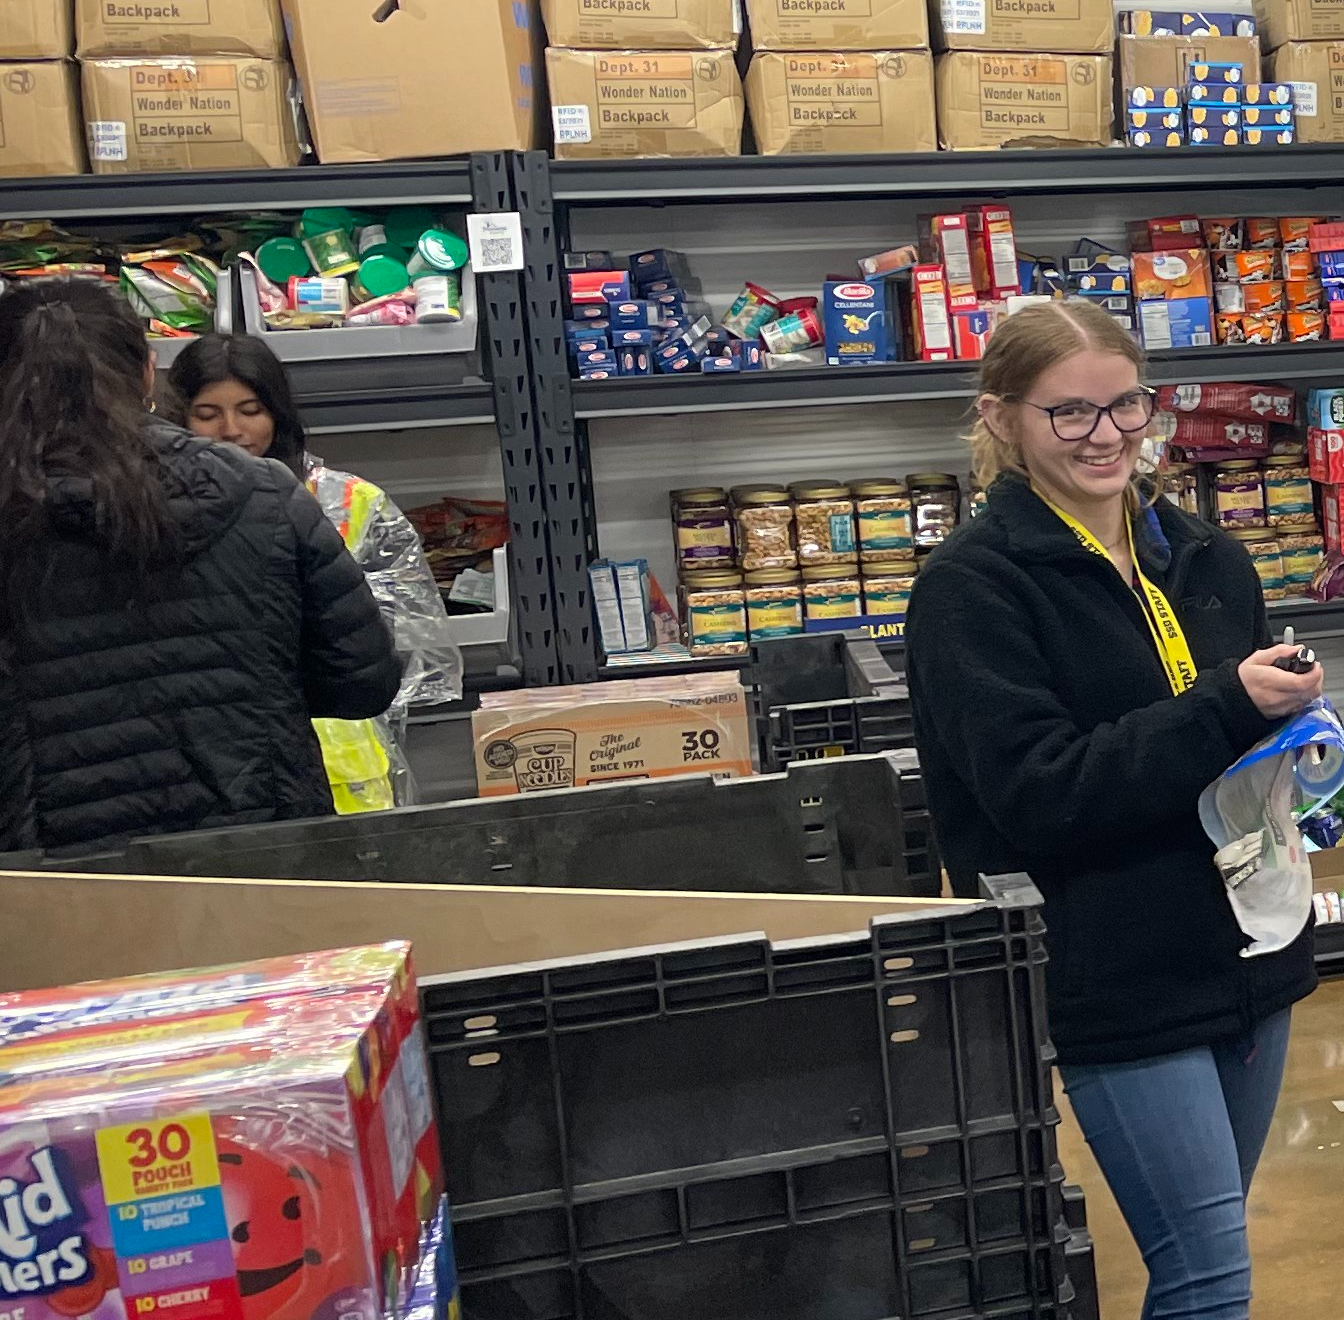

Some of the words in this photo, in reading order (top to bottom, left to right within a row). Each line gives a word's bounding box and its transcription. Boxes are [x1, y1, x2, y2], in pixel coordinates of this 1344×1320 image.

[107, 3, 180, 20] Backpack
[582, 0, 651, 12] Backpack
[781, 0, 846, 12] Backpack
[995, 0, 1056, 13] Backpack
[599, 60, 639, 75] Dept.
[642, 60, 660, 73] 31
[788, 60, 828, 75] Dept.
[830, 60, 847, 73] 31
[982, 62, 1019, 79] Dept.
[1023, 64, 1038, 78] 31
[136, 71, 178, 89] Dept.
[184, 70, 201, 84] 31
[600, 85, 644, 99] Wonder
[649, 85, 687, 99] Nation
[790, 84, 833, 98] Wonder
[836, 83, 873, 97] Nation
[983, 87, 1023, 101] Wonder
[1026, 88, 1062, 102] Nation
[136, 97, 183, 111] Wonder
[190, 97, 231, 110] Nation
[602, 109, 671, 126] Backpack
[793, 107, 858, 122] Backpack
[984, 110, 1046, 126] Backpack
[139, 122, 213, 139] Backpack
[600, 733, 625, 748] The
[681, 729, 720, 751] 30
[589, 736, 642, 762] Original
[682, 748, 720, 762] PACK
[527, 756, 565, 773] CUP
[590, 761, 620, 773] SINCE
[623, 760, 645, 769] 1971
[520, 767, 573, 788] NOODLES
[125, 1123, 191, 1168] 30
[132, 1161, 192, 1187] POUCH
[118, 1205, 138, 1221] 10
[140, 1194, 205, 1217] TROPICAL
[142, 1211, 189, 1231] PUNCH
[127, 1259, 147, 1274] 10
[149, 1250, 194, 1270] GRAPE
[136, 1297, 155, 1314] 10
[157, 1286, 210, 1308] CHERRY
